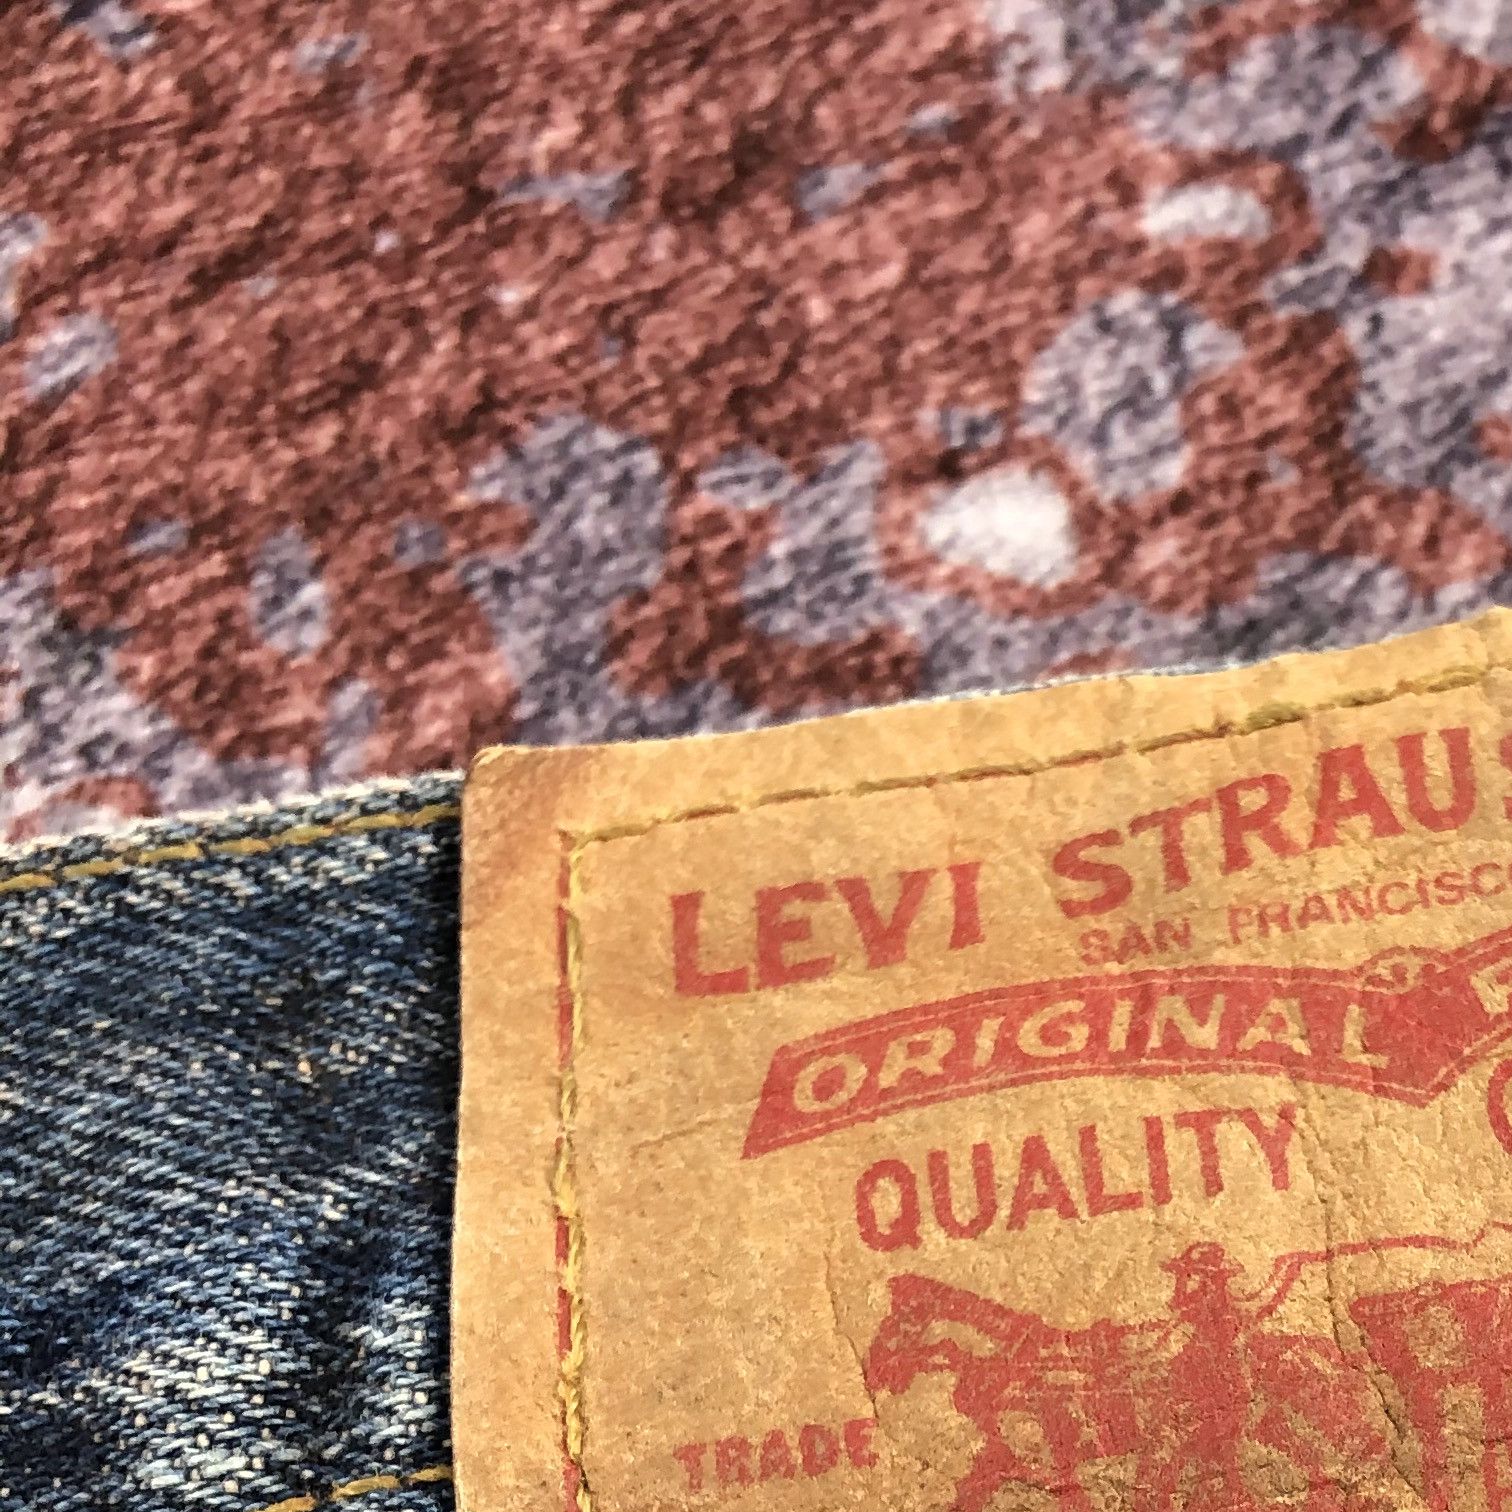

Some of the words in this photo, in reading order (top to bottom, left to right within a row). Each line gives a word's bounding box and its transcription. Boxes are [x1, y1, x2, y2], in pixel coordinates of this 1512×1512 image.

[668, 860, 985, 1000] LEVI
[1077, 916, 1193, 966] SAN
[792, 992, 1391, 1114] ORIGINAL
[853, 1101, 1299, 1254] QUALITY
[672, 1417, 880, 1494] TRADE
